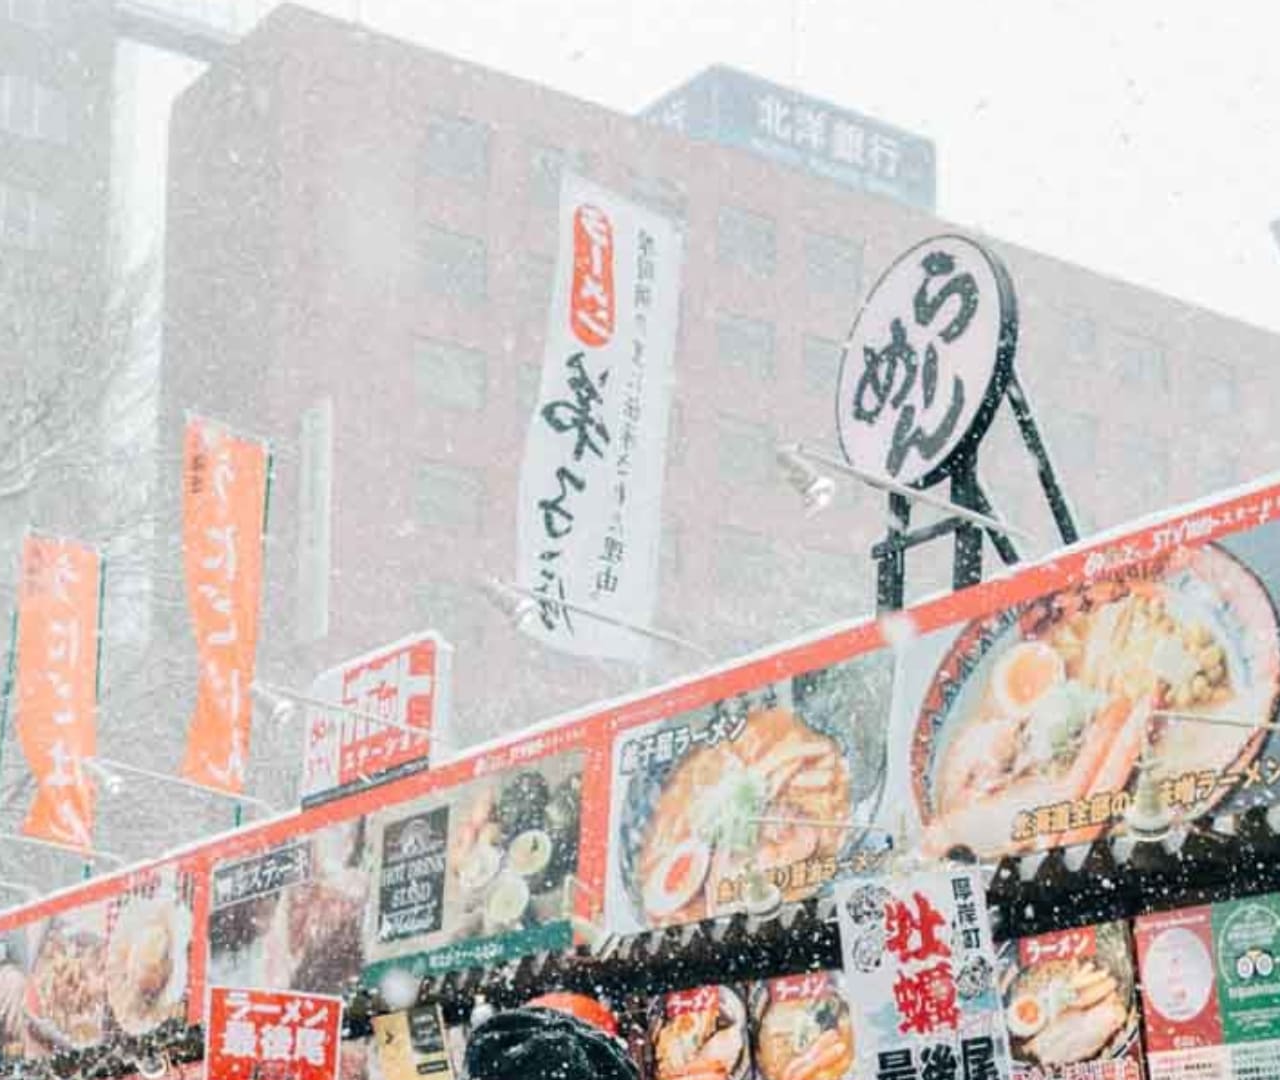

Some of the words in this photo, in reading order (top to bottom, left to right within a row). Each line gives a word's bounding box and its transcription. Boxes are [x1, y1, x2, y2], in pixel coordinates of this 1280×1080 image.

[758, 97, 900, 180] 北洋銀行
[1024, 932, 1087, 958] ラーメン
[225, 993, 328, 1026] ラーメン
